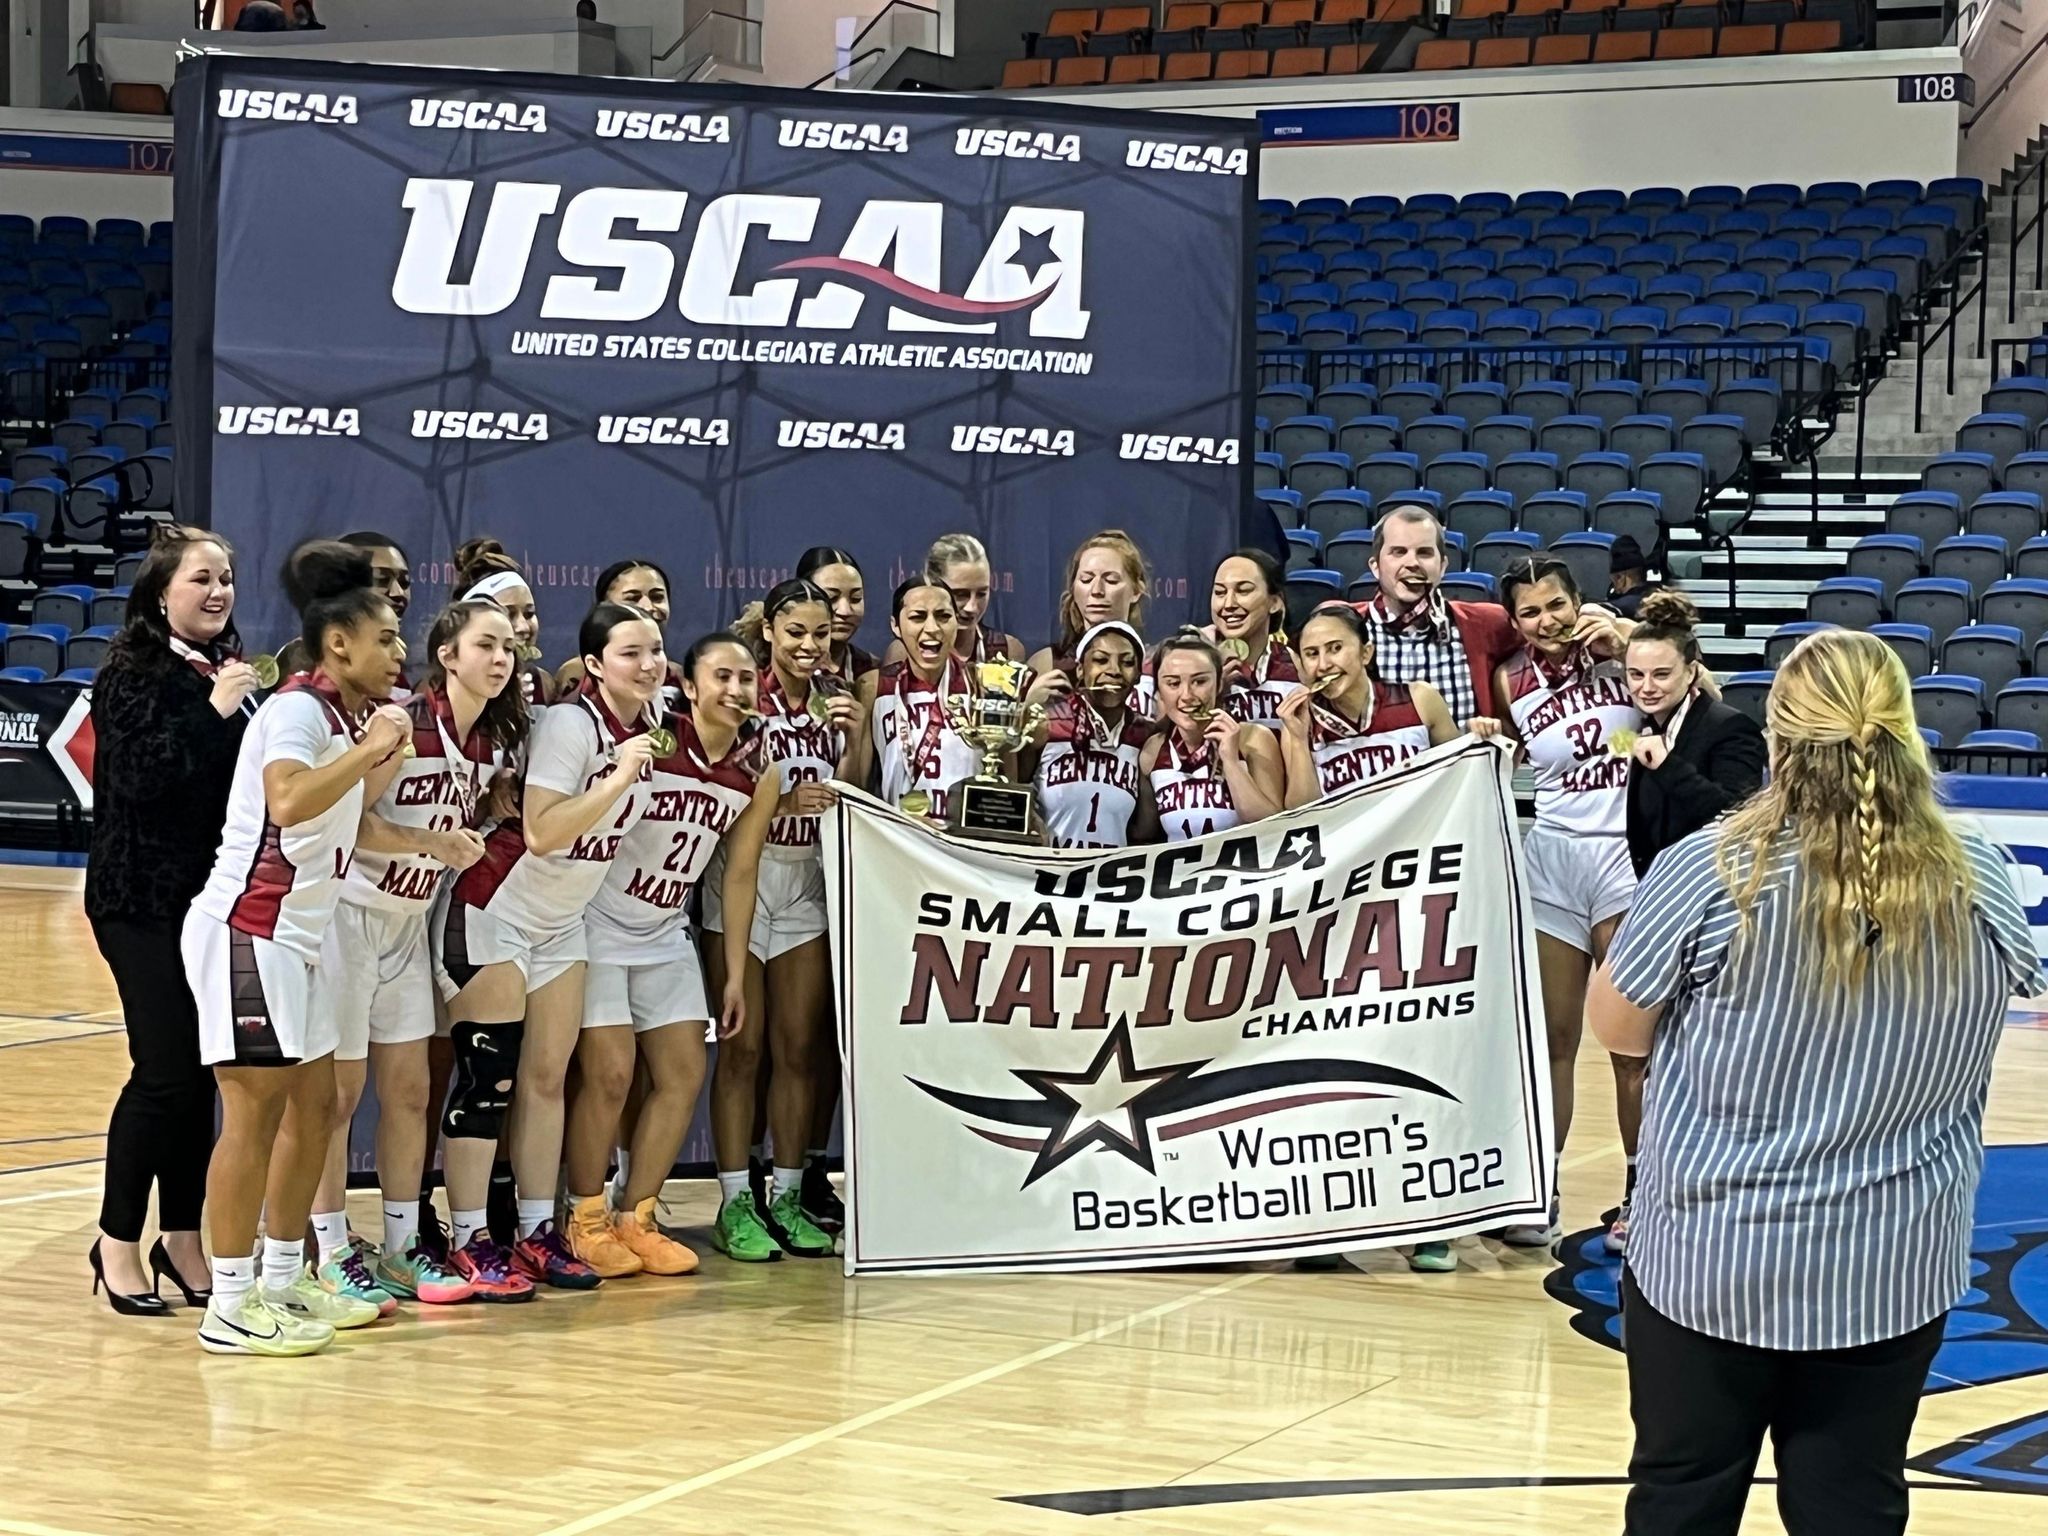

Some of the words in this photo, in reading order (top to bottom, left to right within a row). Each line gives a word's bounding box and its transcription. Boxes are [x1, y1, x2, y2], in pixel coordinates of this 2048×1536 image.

[1913, 76, 1956, 101] 108
[217, 89, 359, 124] USCAA
[409, 99, 547, 133] USCAA
[1399, 104, 1454, 139] 108
[595, 109, 730, 143] USCAA
[778, 119, 909, 153] USCAA
[127, 143, 174, 173] 107
[954, 128, 1081, 162] USCAA
[1125, 140, 1249, 176] USCAA
[391, 177, 1091, 340] USCAA
[511, 331, 599, 357] UNITED
[603, 335, 692, 360] STATES
[696, 338, 837, 365] COLLEGIATE
[839, 343, 948, 369] ATHLETIC
[948, 346, 1093, 375] ASSOCIATION
[217, 406, 361, 436] USCAA
[411, 409, 549, 441] USCAA
[597, 415, 729, 446] USCAA
[777, 420, 906, 450] USCAA
[950, 425, 1075, 456] USCAA
[1119, 433, 1240, 465] USCAA
[1565, 718, 1609, 761] 32
[1087, 792, 1100, 833] 1
[767, 815, 822, 847] MAIN
[662, 831, 702, 875] 21
[1034, 824, 1327, 903] USCAA
[624, 867, 697, 909] MAIN
[917, 891, 1148, 938] SMALL
[1177, 843, 1464, 936] COLLEGE
[899, 891, 1478, 1031] NATIONAL
[1241, 990, 1476, 1039] CHAMPIONS
[1218, 1113, 1428, 1170] Women's
[1072, 1175, 1311, 1231] Basketball
[1322, 1167, 1377, 1212] DII
[1402, 1147, 1505, 1203] 2022
